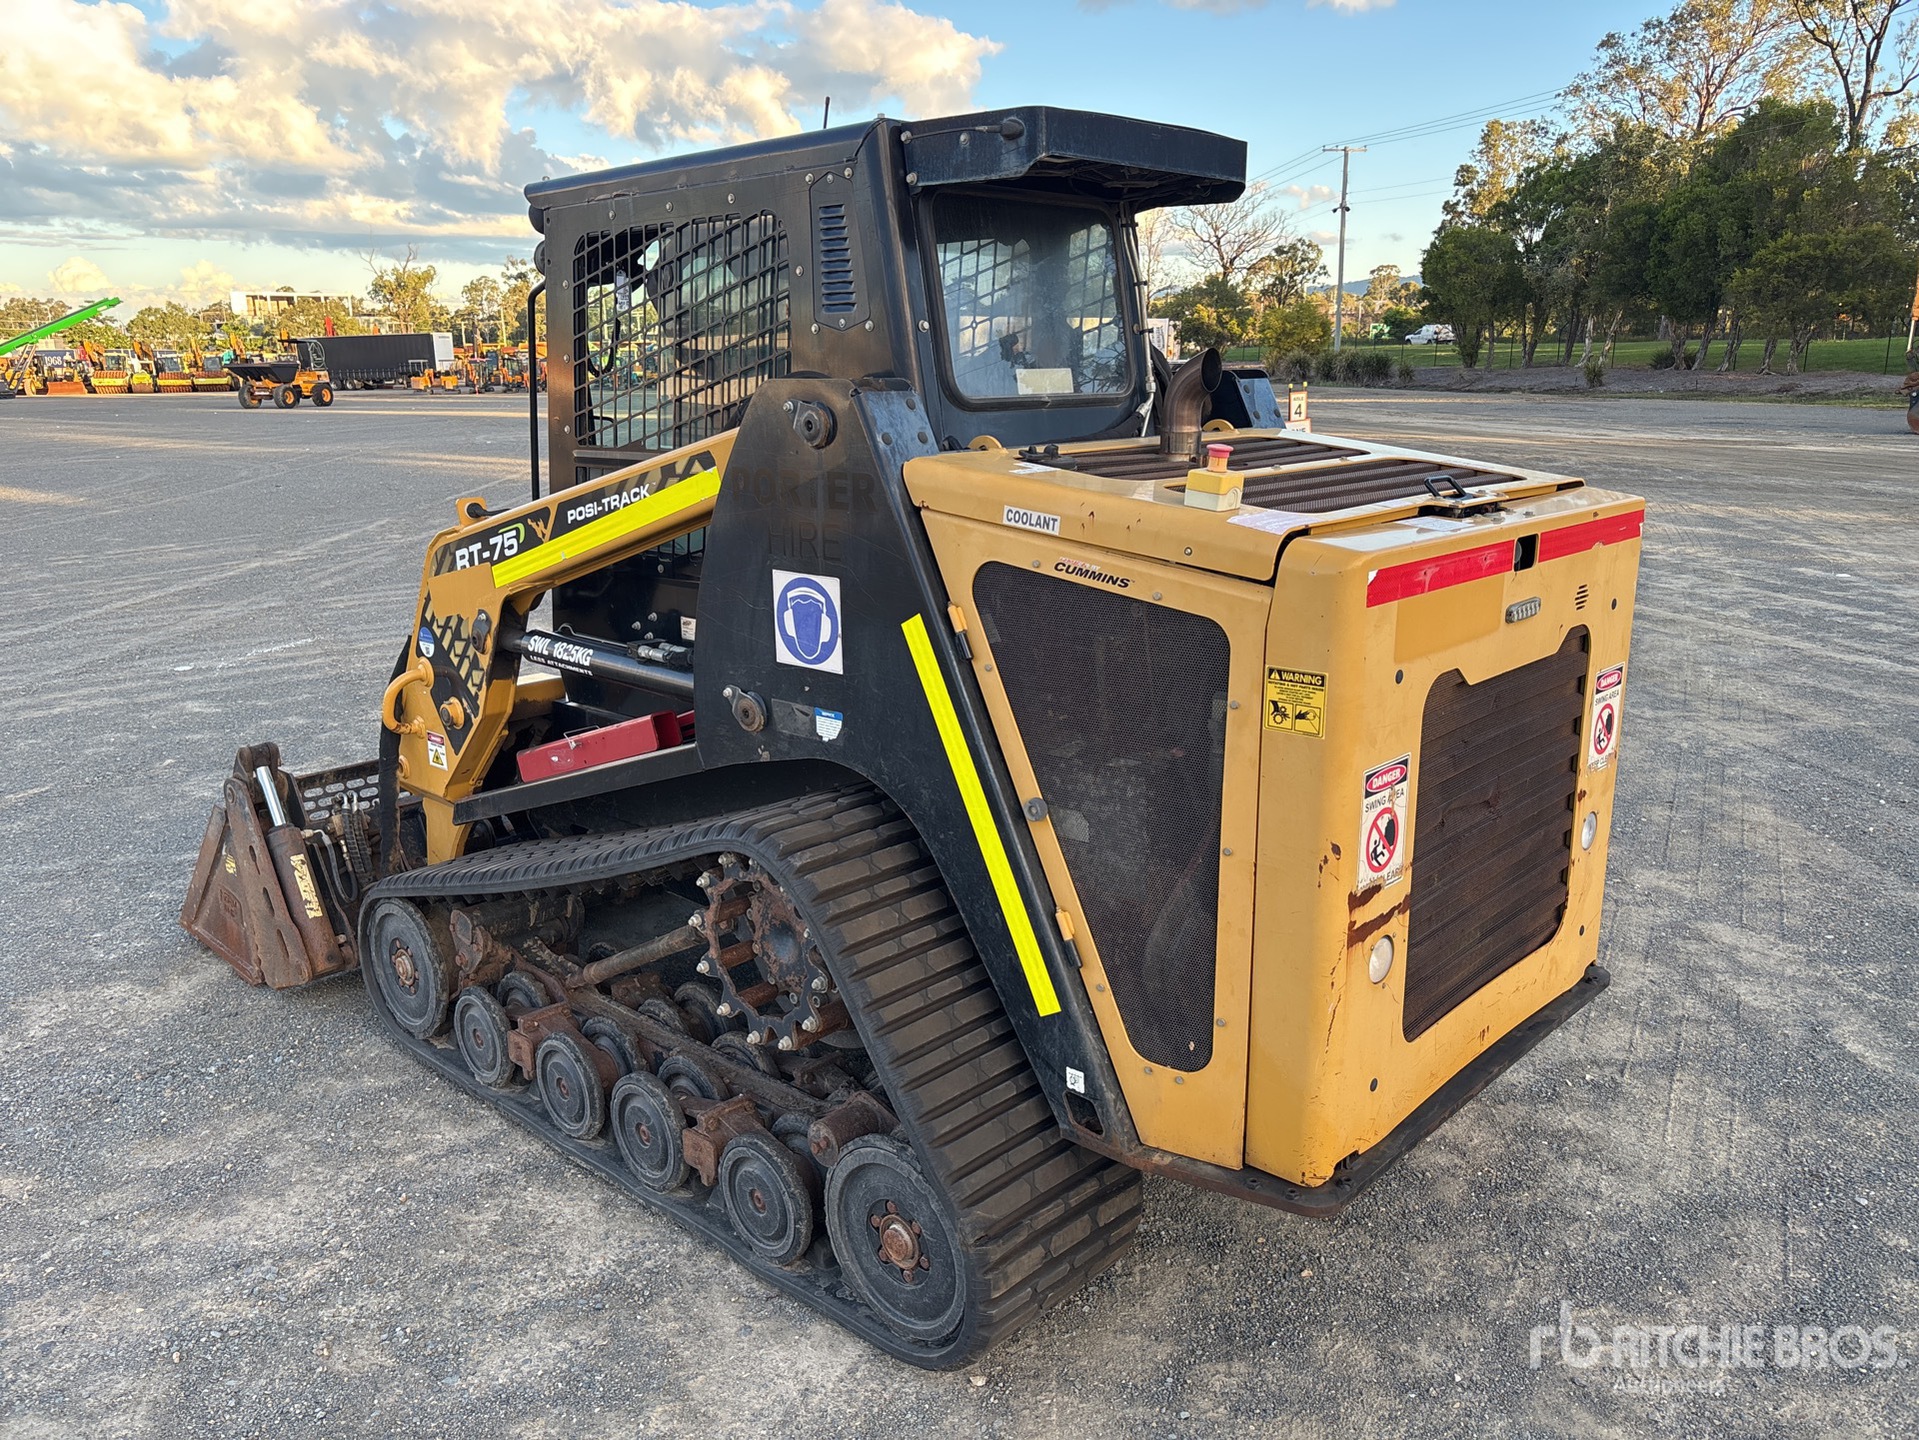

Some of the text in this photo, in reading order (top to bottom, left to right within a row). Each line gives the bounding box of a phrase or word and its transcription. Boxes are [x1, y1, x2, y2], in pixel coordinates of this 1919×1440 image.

[44, 355, 62, 367] 1968
[1294, 403, 1302, 418] 4
[567, 483, 651, 524] POSI-TRACK
[1006, 508, 1058, 532] COOLANT
[455, 530, 519, 571] RT-75
[769, 518, 842, 561] HIRE
[1053, 562, 1131, 588] CUMMINS
[528, 635, 593, 666] SWL 1825KG
[530, 655, 593, 676] LESS ATTACHMENTS
[1281, 671, 1322, 685] WARNING
[1372, 768, 1400, 789] DANGER
[1364, 787, 1405, 813] SWING AEA
